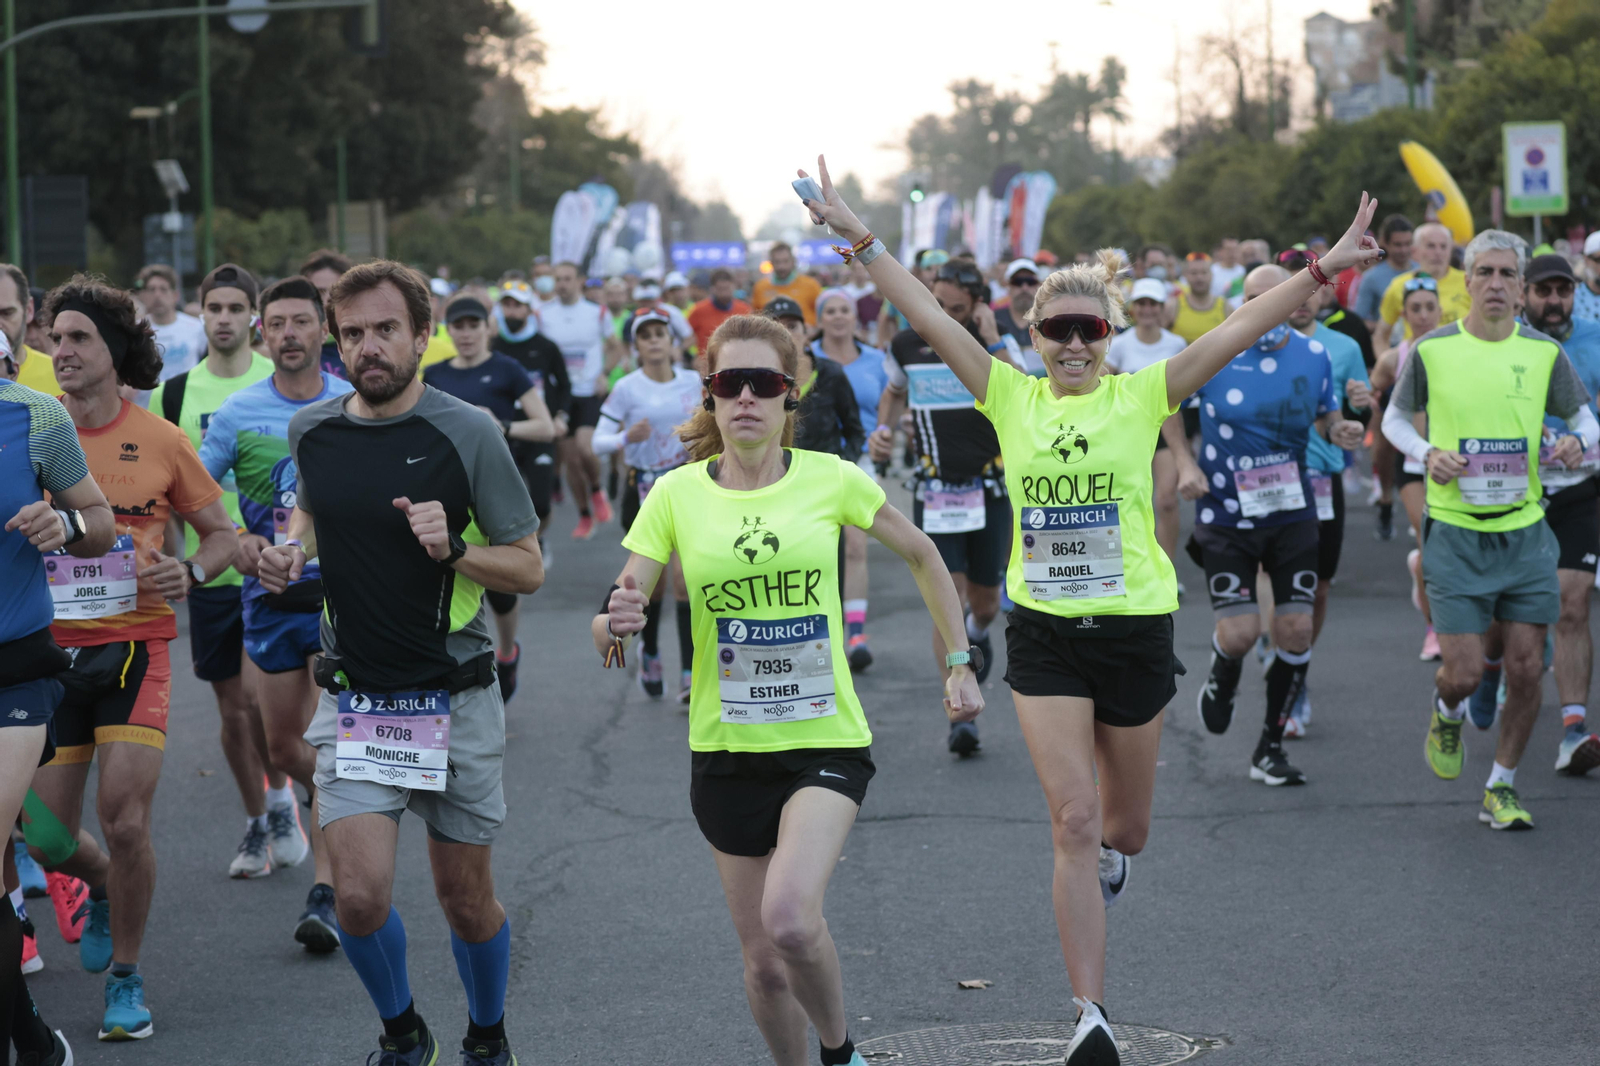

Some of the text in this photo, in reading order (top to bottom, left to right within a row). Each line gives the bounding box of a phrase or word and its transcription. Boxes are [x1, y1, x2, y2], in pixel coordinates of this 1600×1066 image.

[1482, 441, 1522, 452] ZURICH
[1487, 480, 1503, 488] EDU
[1049, 509, 1106, 525] ZURICH
[1051, 541, 1087, 556] 8642
[73, 564, 103, 578] 6791
[1048, 564, 1093, 577] RAQUEL
[73, 585, 107, 597] JORGE
[701, 568, 822, 613] ESTHER
[751, 621, 814, 640] ZURICH
[753, 658, 792, 675] 7935
[750, 683, 800, 698] ESTHER
[375, 724, 412, 741] 6708
[365, 745, 420, 763] MONICHE
